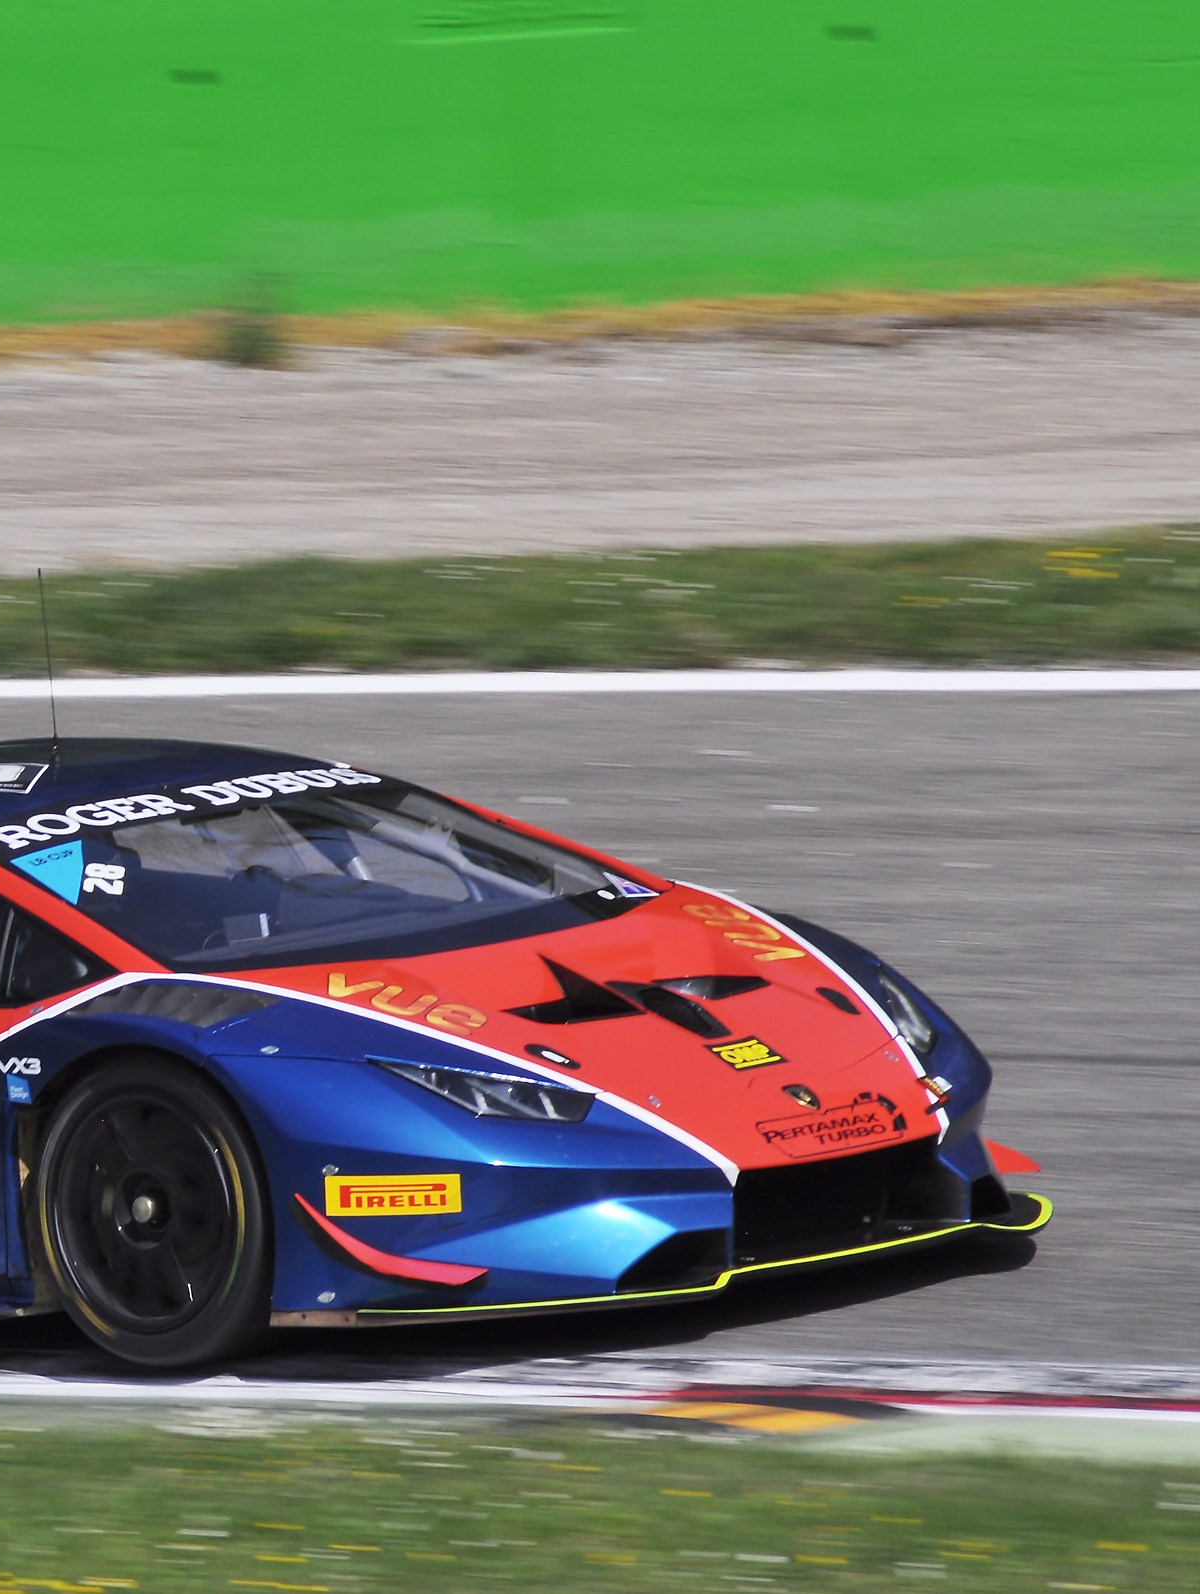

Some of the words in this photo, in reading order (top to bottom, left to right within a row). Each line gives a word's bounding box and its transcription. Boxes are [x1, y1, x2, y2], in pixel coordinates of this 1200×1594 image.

[181, 767, 382, 806] DUBUIS
[83, 862, 126, 896] 28
[762, 1112, 880, 1144] PERTAMAX
[815, 1123, 887, 1146] TURBO
[339, 1183, 448, 1209] PIRELLI
